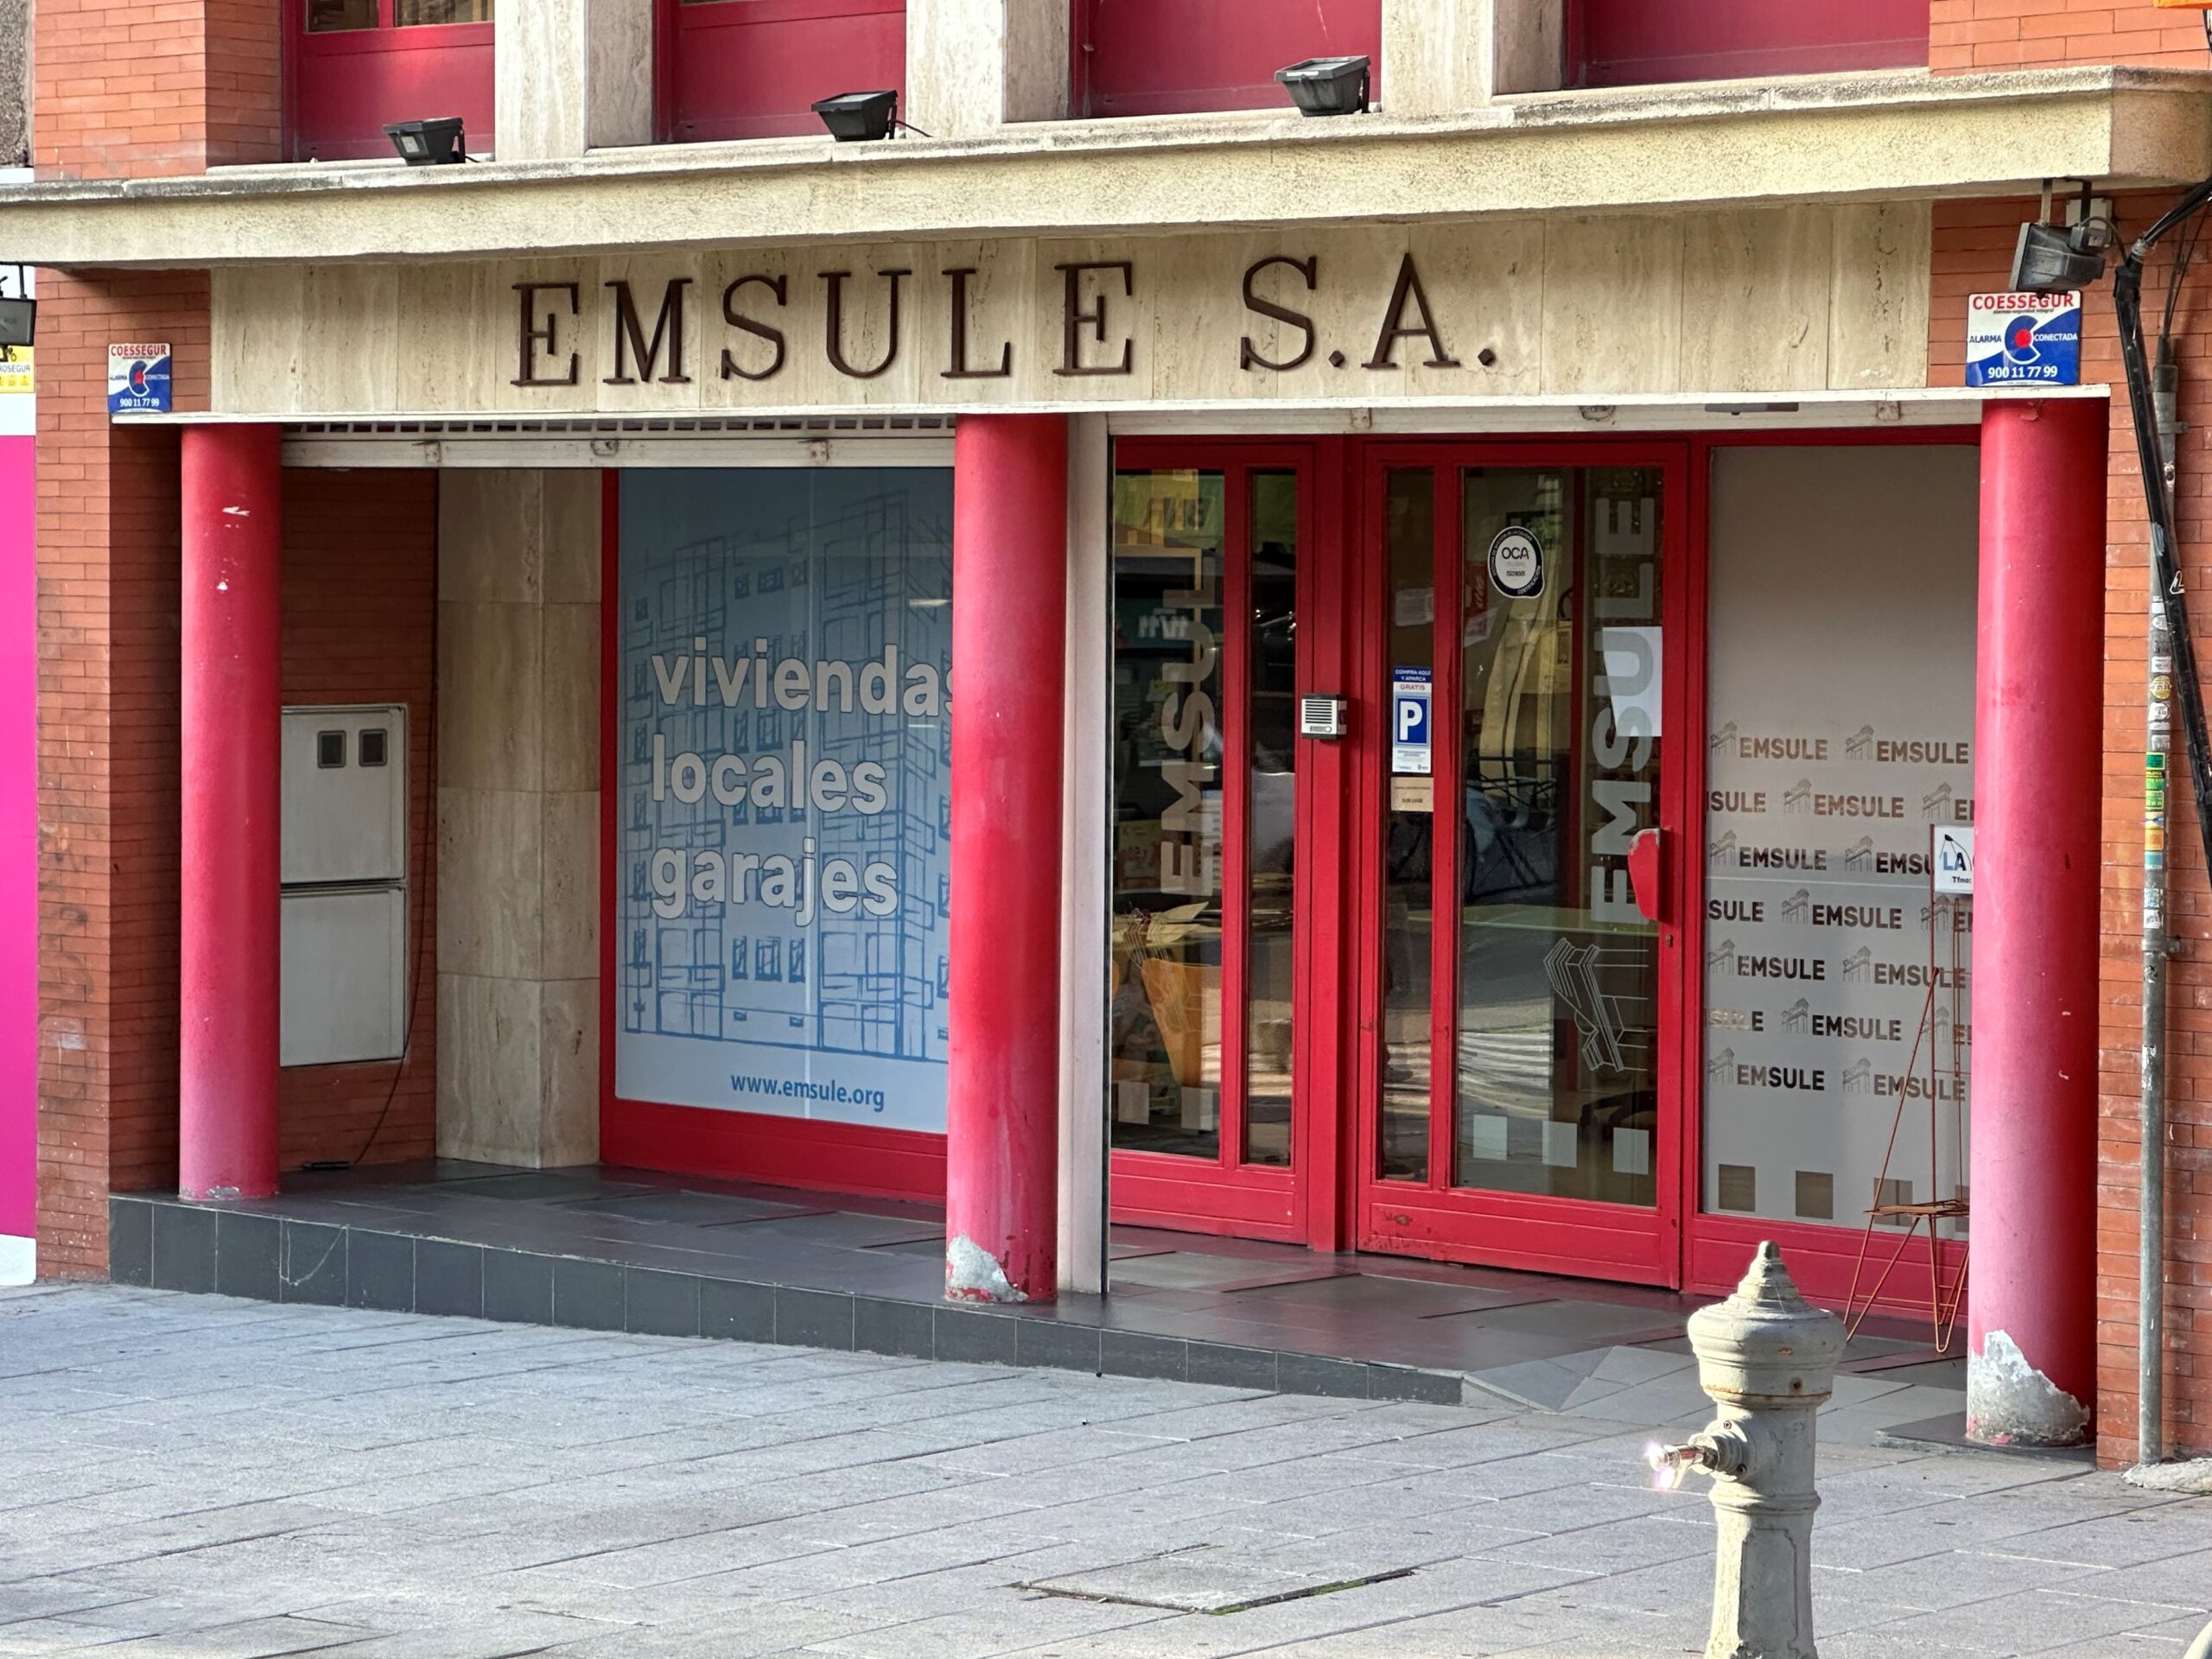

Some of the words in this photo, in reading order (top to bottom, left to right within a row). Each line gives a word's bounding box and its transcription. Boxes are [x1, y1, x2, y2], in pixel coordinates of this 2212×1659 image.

[1974, 294, 2074, 310] COESSEGUR
[511, 262, 1132, 386] EMSULE
[1240, 253, 1496, 371] S.A.
[1969, 334, 2002, 343] ALARMA
[2034, 333, 2078, 341] CONECTADA
[111, 346, 167, 356] COESSEGUR
[1988, 366, 2009, 378] 900
[2012, 366, 2024, 378] 11
[2028, 366, 2042, 378] 77
[2044, 365, 2058, 378] 99
[119, 398, 132, 407] 900
[134, 398, 141, 407] 11
[143, 398, 150, 407] 77
[151, 398, 160, 407] 99
[1502, 547, 1529, 559] OCA
[1400, 701, 1423, 741] P
[1591, 497, 1655, 925] EMSULE
[1160, 556, 1215, 897] EMSUL
[1739, 737, 1827, 760] EMSULE
[1876, 741, 1969, 765] EMSULE
[652, 733, 888, 815] locales
[1707, 791, 1766, 813] SULE
[1815, 794, 1904, 818] EMSULE
[1739, 847, 1827, 871] EMSULE
[1943, 852, 1967, 871] LA
[651, 836, 899, 928] garajes
[1812, 905, 1902, 929] EMSULE
[1738, 955, 1825, 981] EMSULE
[1874, 963, 1967, 989] EMSULE
[1812, 1014, 1902, 1041] EMSULE
[1737, 1064, 1825, 1091] EMSULE
[1874, 1074, 1966, 1102] EMSULE
[731, 1074, 885, 1113] www.emsule.org
